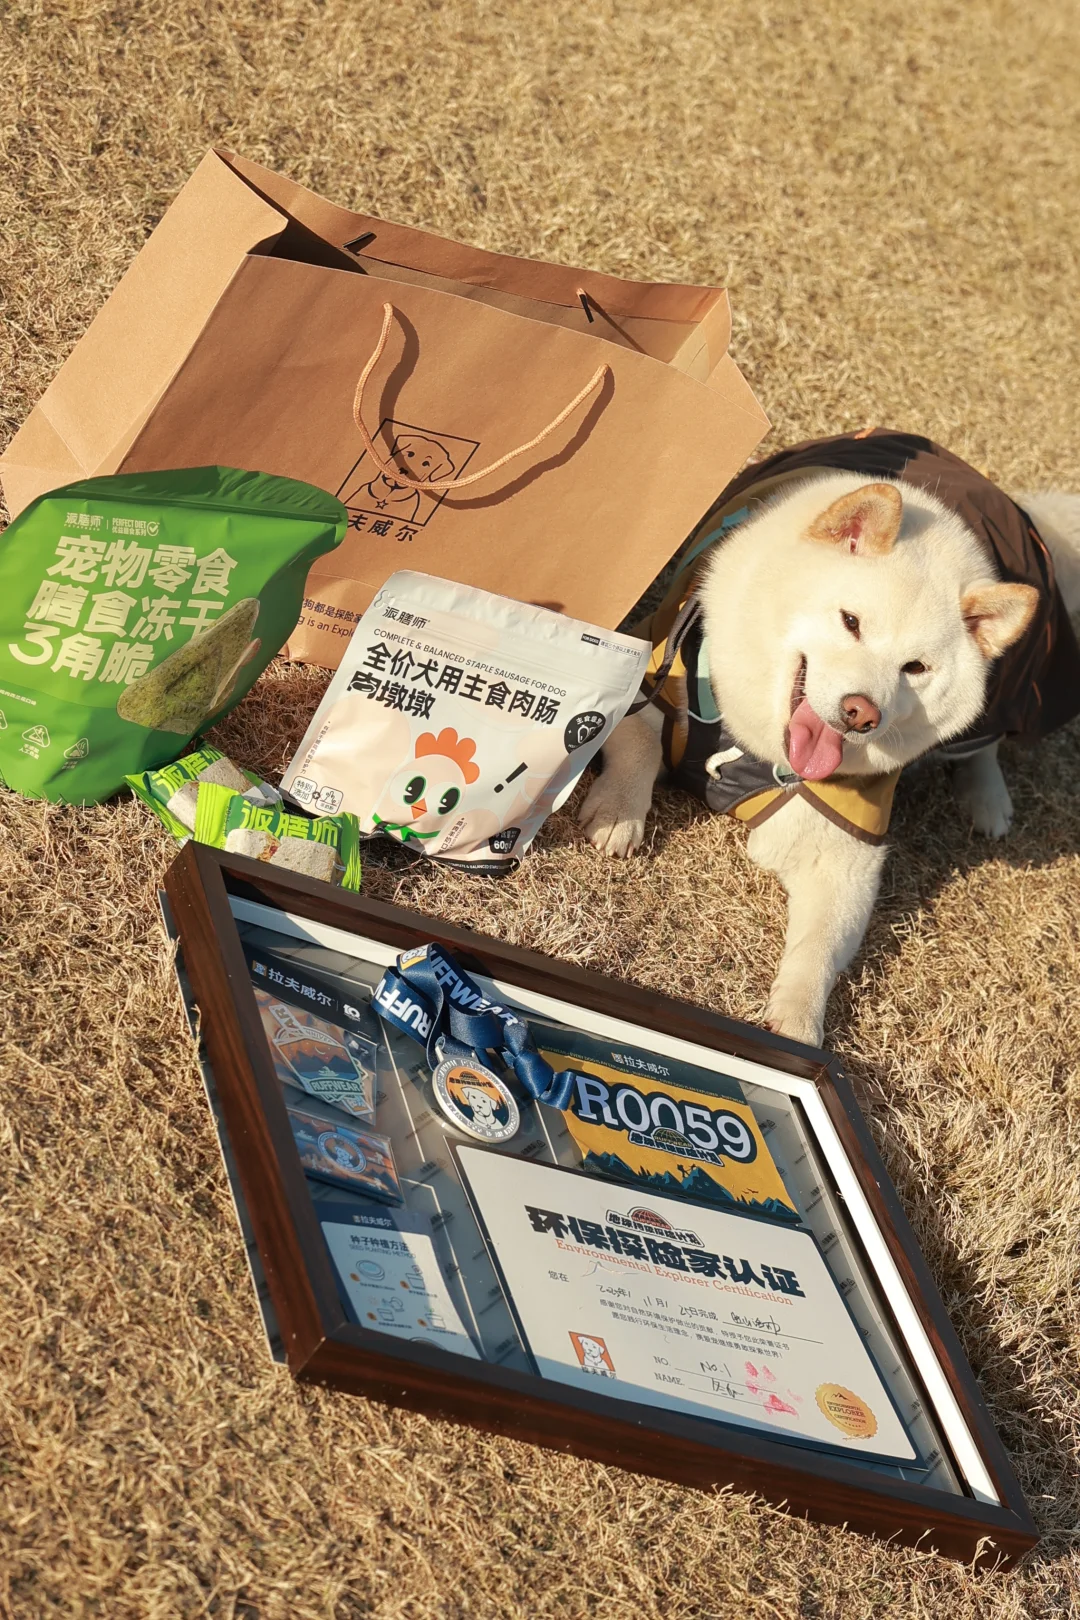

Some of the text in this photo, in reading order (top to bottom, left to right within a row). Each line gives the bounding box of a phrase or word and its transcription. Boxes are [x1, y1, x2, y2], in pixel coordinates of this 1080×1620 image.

[112, 517, 147, 529] PERFECT DIET
[348, 513, 419, 542] 夫威尔
[46, 534, 238, 597] 宠物零食
[26, 579, 226, 642] 膳食冻干
[307, 616, 316, 627] is
[317, 622, 330, 632] an
[382, 606, 428, 629] 派膳师
[8, 621, 156, 686] 3角脆
[373, 628, 567, 697] COMPLETE & BALANCED STAPLE SAUSAGE FOR DOG
[347, 670, 437, 720] 肉墩墩
[362, 641, 562, 726] 全价犬用主食肉肠
[239, 800, 338, 851] 派膳师
[268, 968, 332, 1007] 拉夫威尔
[429, 949, 518, 1027] UFFWEAR
[312, 1081, 360, 1093] RUFFWEAR
[624, 1054, 670, 1077] 拉夫威尔
[575, 1075, 752, 1160] R0059
[350, 1235, 411, 1252] 种子种植方法
[525, 1204, 806, 1299] 环保探险家认证
[548, 1270, 570, 1282] 您在
[555, 1239, 794, 1306] Environmental Explorer Certification
